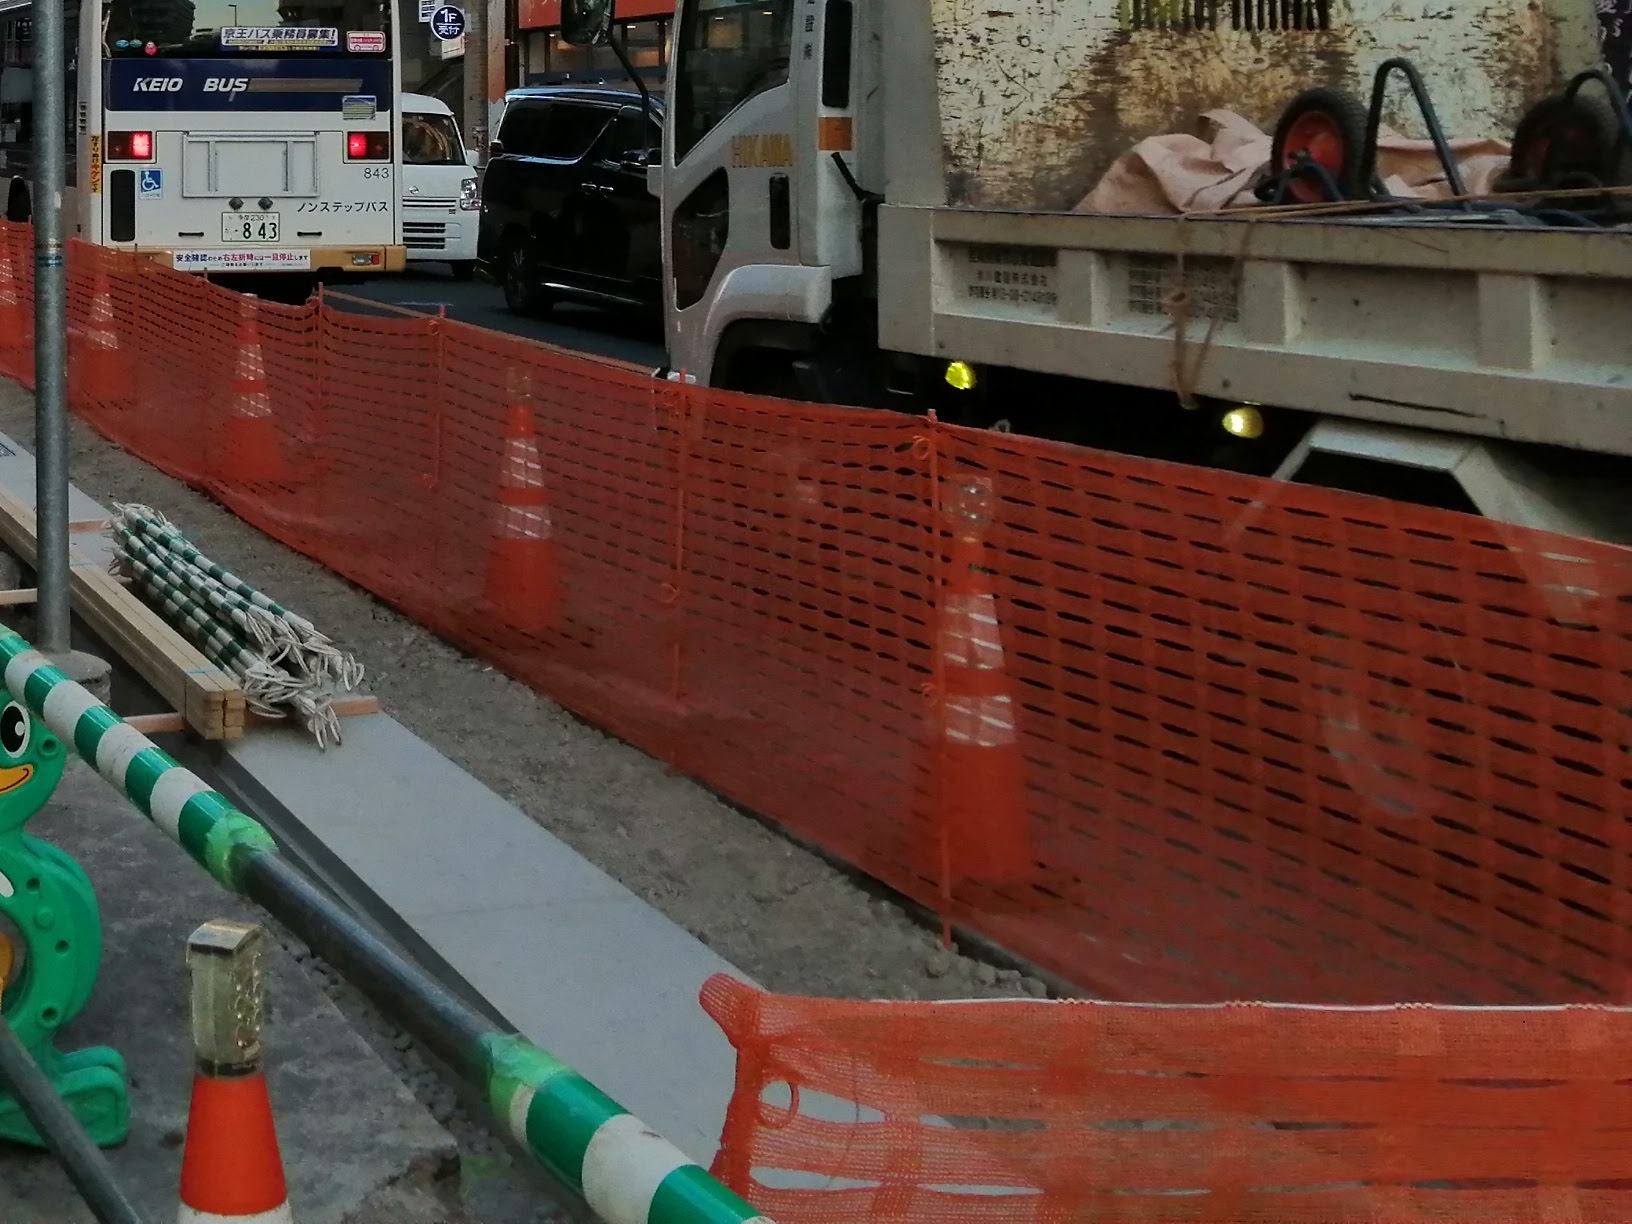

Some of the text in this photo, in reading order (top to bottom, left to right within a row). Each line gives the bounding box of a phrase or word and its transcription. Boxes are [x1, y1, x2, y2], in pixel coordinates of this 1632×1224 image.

[440, 8, 458, 23] 1F
[438, 25, 460, 35] 受付
[133, 78, 249, 92] KEIO BUS
[363, 167, 389, 179] 843
[297, 201, 389, 213] ノンステップバス
